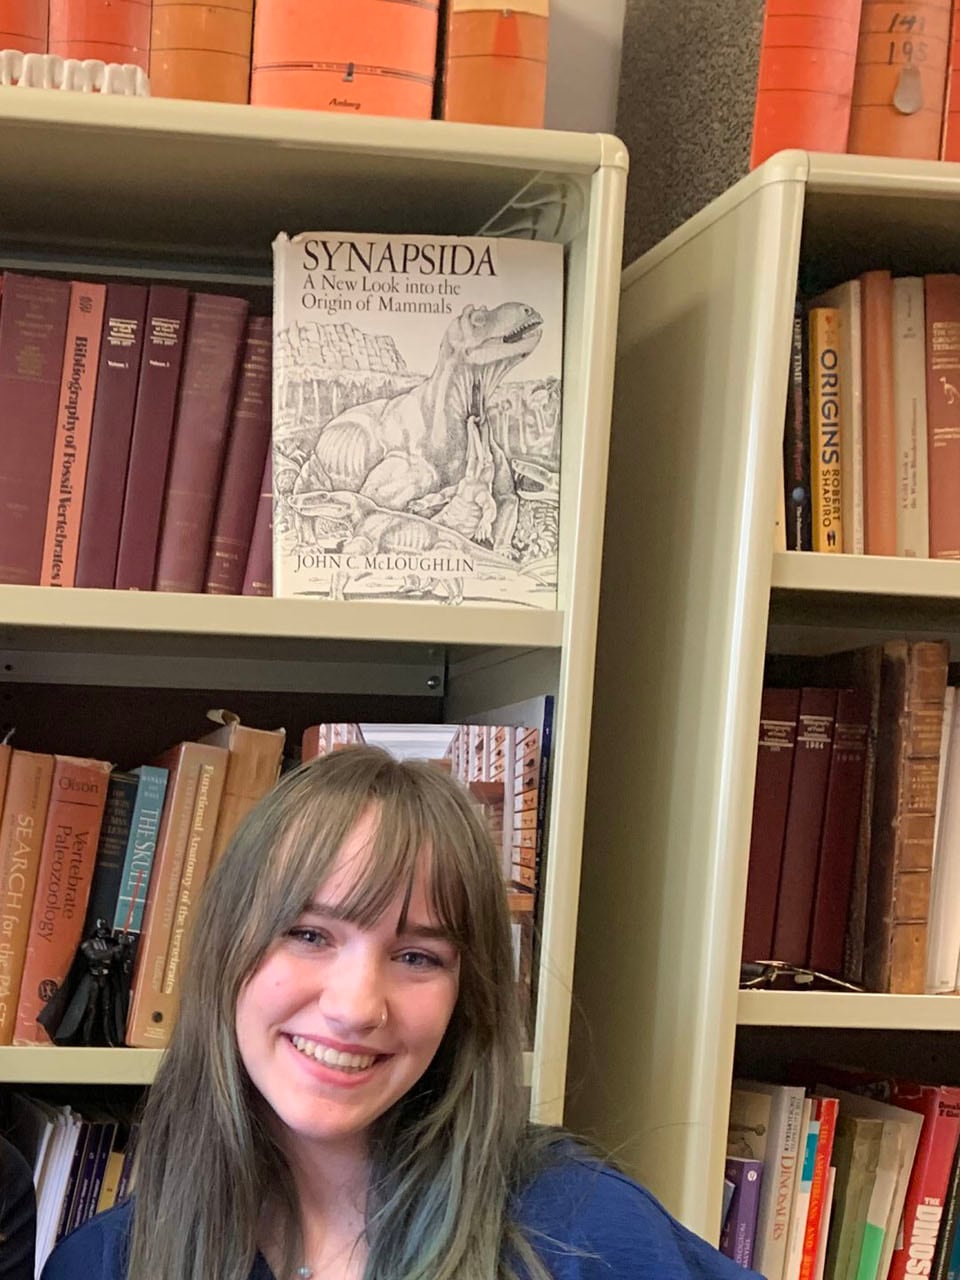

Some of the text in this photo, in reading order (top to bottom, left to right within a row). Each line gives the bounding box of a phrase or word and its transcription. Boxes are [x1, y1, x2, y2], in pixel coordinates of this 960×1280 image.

[302, 239, 497, 277] SYNAPSIDA
[302, 293, 453, 315] Origin of Mammals
[303, 275, 461, 295] A New Look into the
[794, 318, 802, 350] DEEP
[62, 335, 88, 435] Bibliography
[794, 354, 803, 382] TIME
[820, 348, 839, 466] ORIGINS
[63, 437, 76, 451] of
[59, 451, 77, 498] Fossil
[821, 469, 831, 528] SHAPIRO
[831, 469, 840, 521] ROBERT
[51, 498, 73, 577] Vertebrates
[294, 554, 341, 573] JOHN
[364, 556, 475, 573] McLOUGHLIN
[59, 776, 99, 794] Olson
[194, 764, 214, 832] Functional
[6, 814, 34, 910] SEARCH
[63, 829, 90, 921] Vertebrate
[128, 807, 160, 892] THE SKULL
[181, 832, 202, 889] Anatomy
[40, 824, 73, 944] Paleozoology
[2, 912, 21, 935] for
[177, 905, 189, 926] the
[0, 938, 19, 970] the
[165, 928, 184, 995] Vertebrates
[773, 1155, 795, 1241] DINOSAURS
